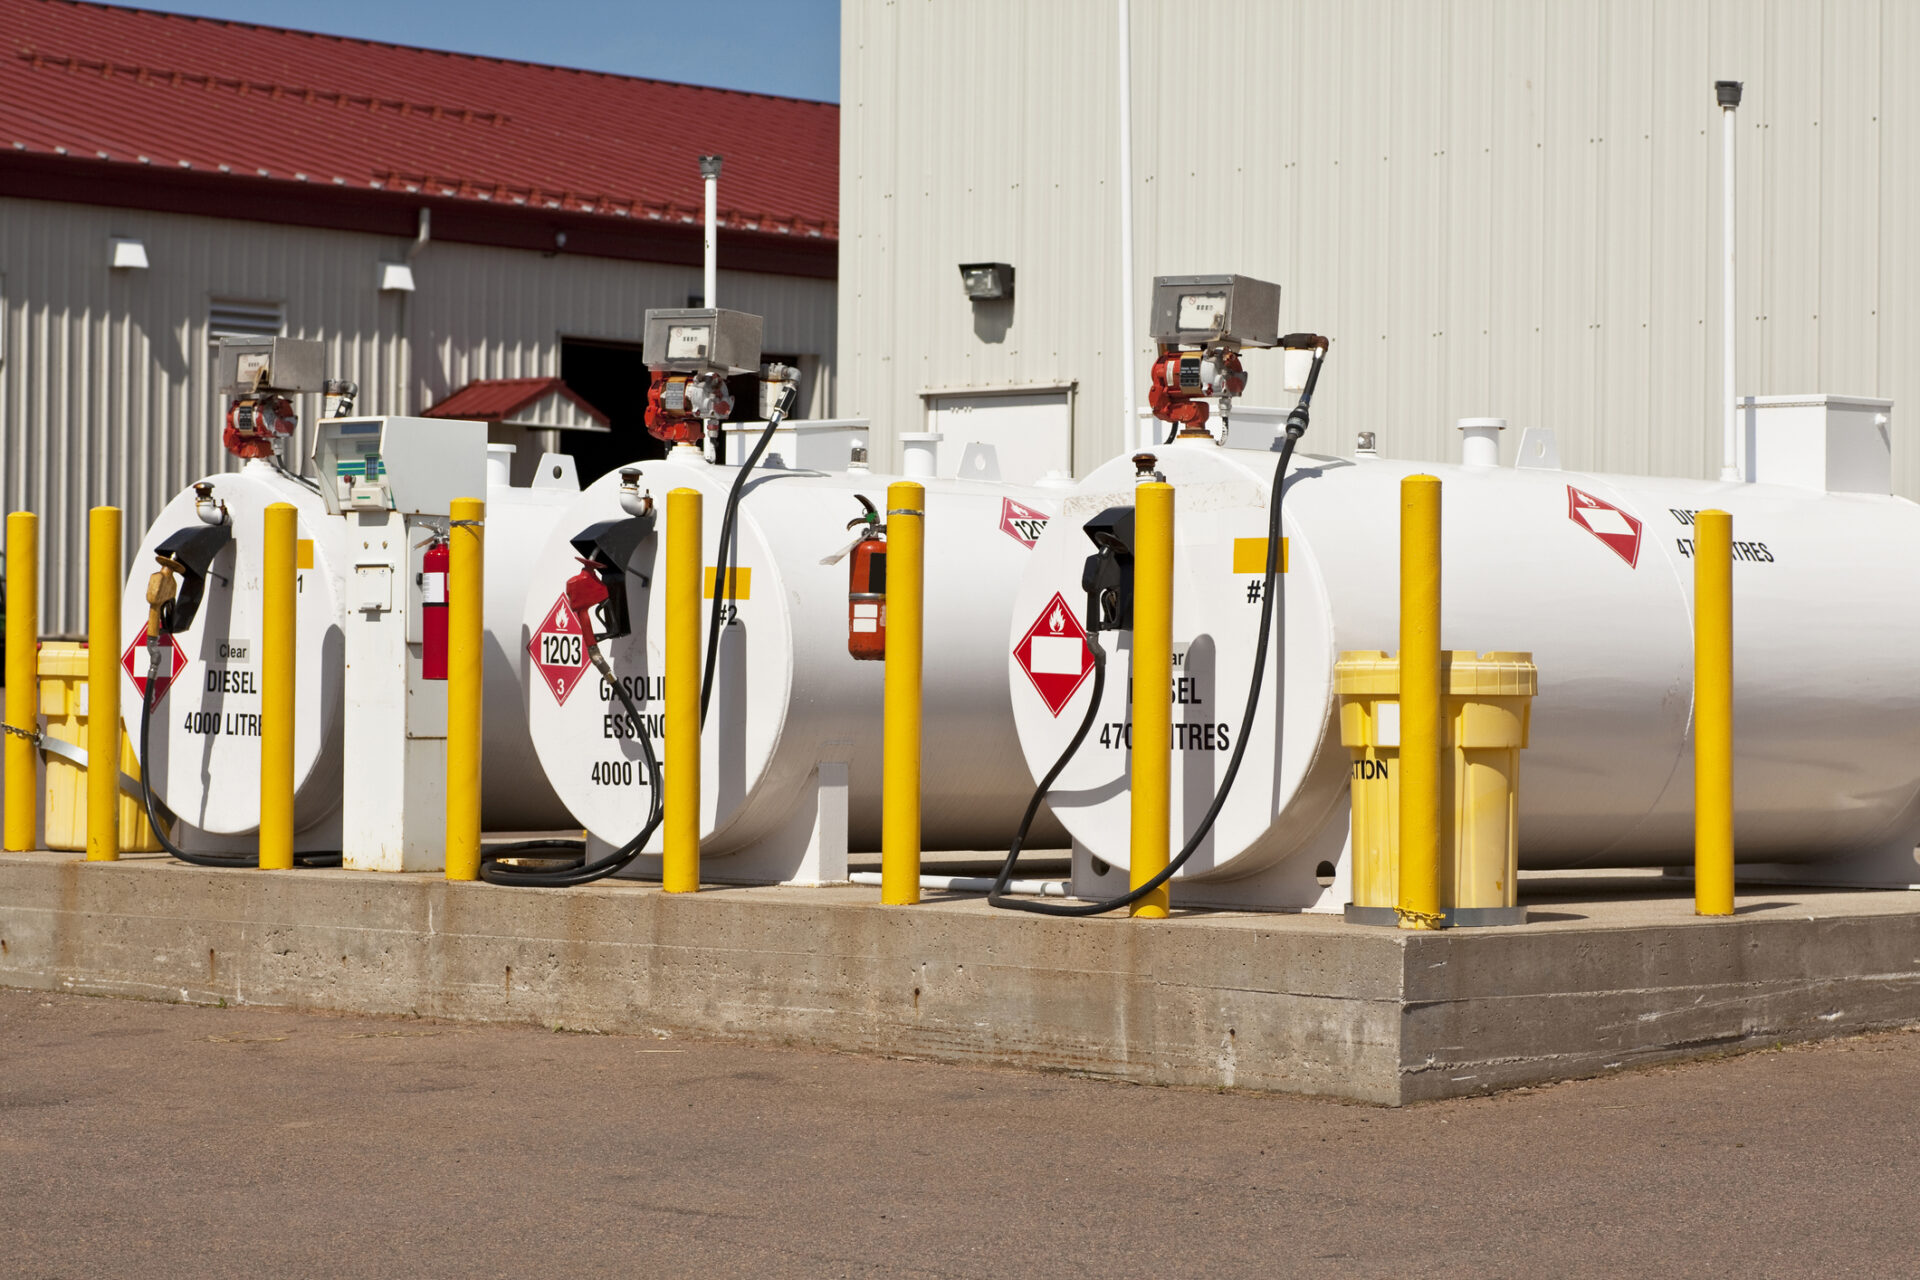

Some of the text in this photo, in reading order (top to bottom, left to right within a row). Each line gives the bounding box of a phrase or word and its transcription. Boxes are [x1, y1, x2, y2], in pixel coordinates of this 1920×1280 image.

[1014, 520, 1047, 540] 120
[1676, 538, 1774, 563] 47 TRES
[297, 574, 303, 593] 1
[720, 604, 737, 625] #2
[219, 644, 247, 658] Clear
[543, 635, 581, 665] 1203
[207, 670, 257, 694] DIESEL
[557, 678, 565, 695] 3
[600, 676, 665, 701] GASOLI
[184, 712, 262, 736] 4000 LITR
[1100, 723, 1230, 751] 470 ITRES
[591, 761, 632, 785] 4000
